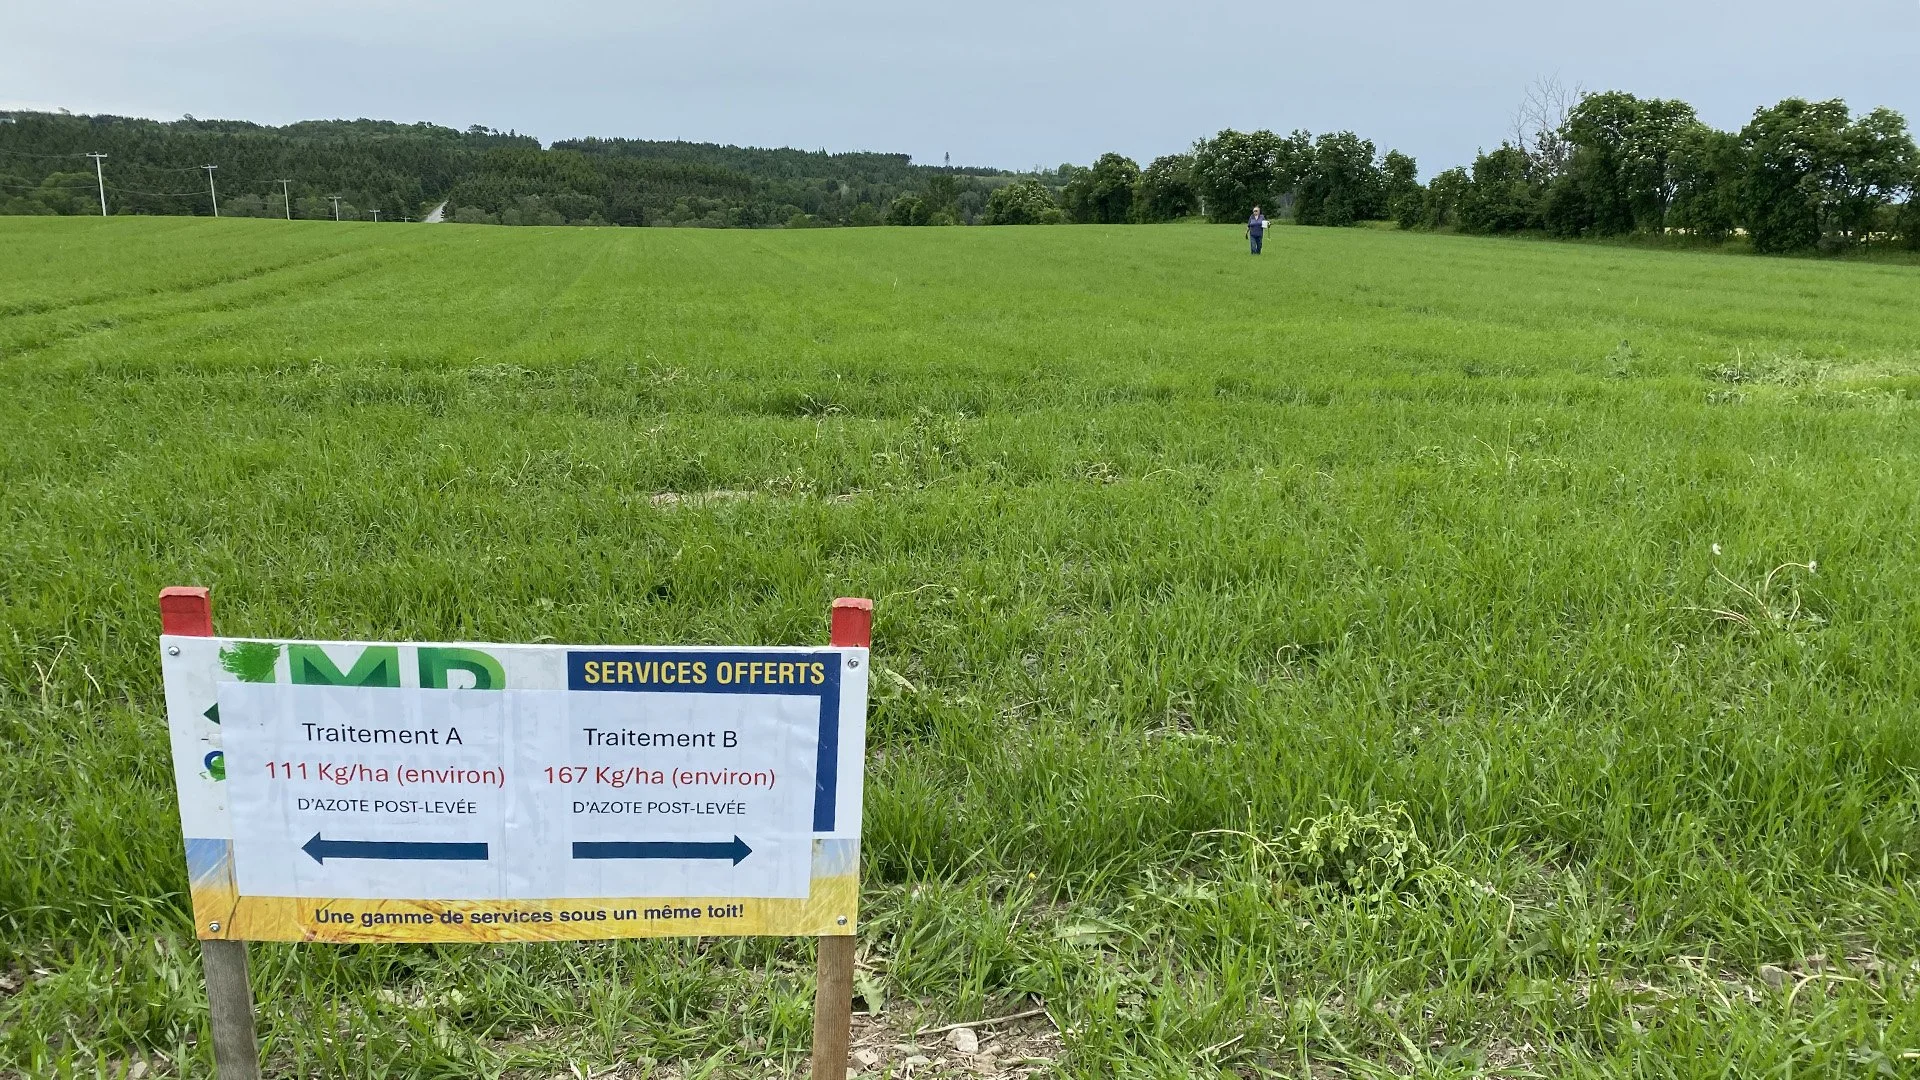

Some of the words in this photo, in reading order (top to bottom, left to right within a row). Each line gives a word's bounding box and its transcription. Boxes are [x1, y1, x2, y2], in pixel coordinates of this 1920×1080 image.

[585, 662, 706, 683] SERVICES
[717, 662, 824, 684] OFFERTS
[302, 723, 439, 744] Traitement
[446, 727, 462, 744] A
[583, 728, 715, 747] Traitement
[724, 731, 737, 747] B
[266, 762, 306, 779] 111
[319, 763, 388, 785] Kg/ha
[398, 765, 504, 788] (environ)
[545, 767, 587, 783] 167
[597, 767, 663, 788] Kg/ha
[673, 768, 774, 790] (environ)
[298, 799, 368, 811] D’AZOTE
[375, 799, 476, 813] POST-LEVÉE
[573, 802, 642, 813] D’AZOTE
[648, 800, 745, 814] POST-LEVÉE
[315, 909, 354, 924] Une
[361, 909, 434, 928] gamme
[440, 908, 463, 925] de
[470, 908, 553, 924] services
[559, 911, 606, 922] sous
[612, 908, 637, 921] un
[644, 904, 701, 920] même
[707, 903, 745, 919] toit!
